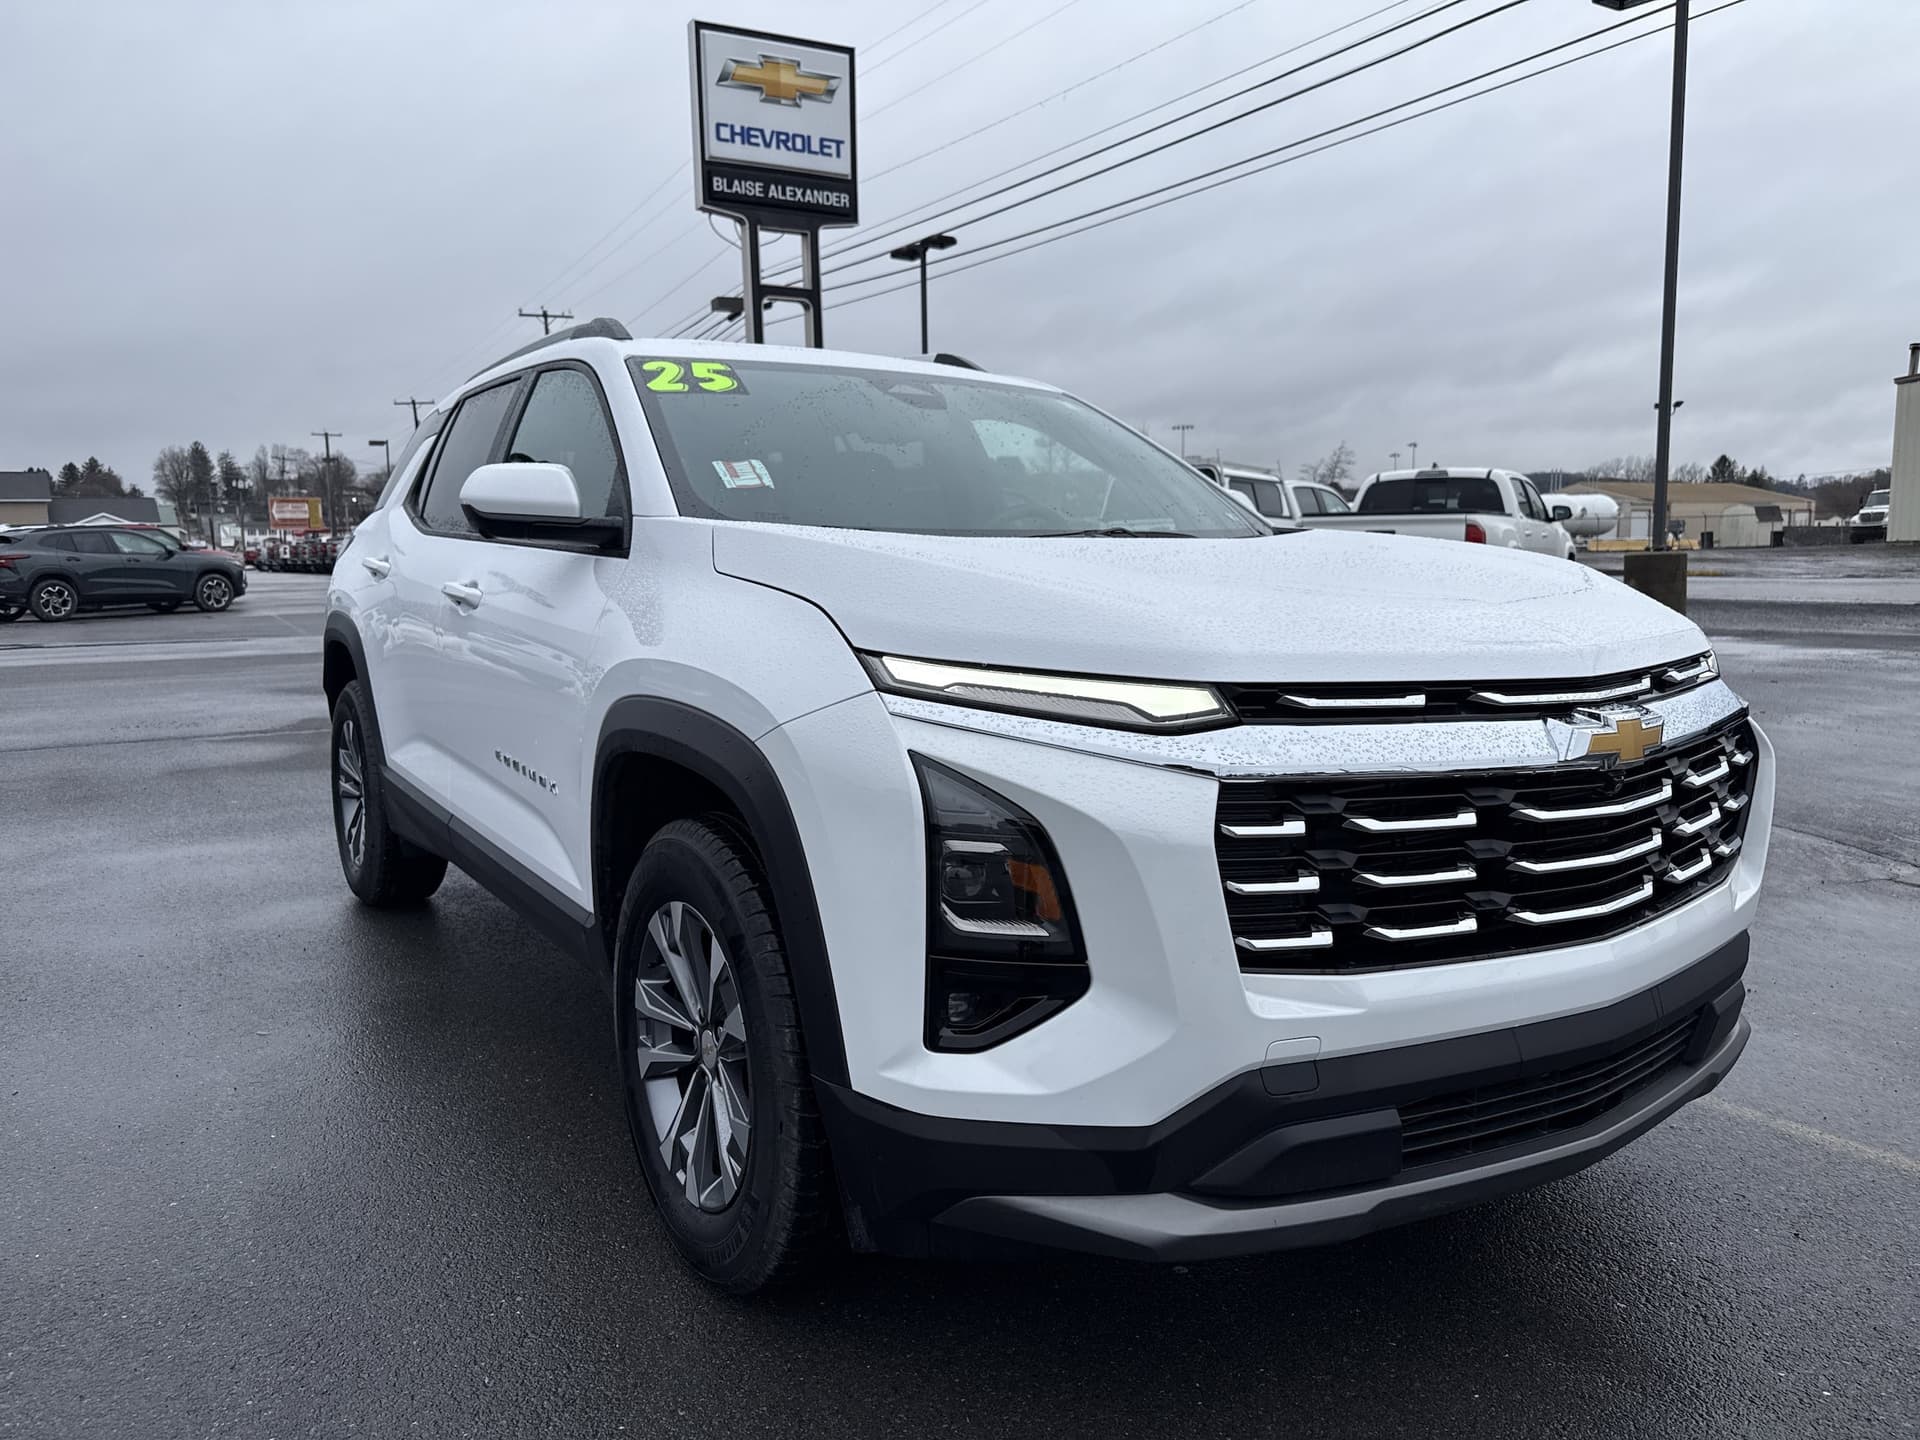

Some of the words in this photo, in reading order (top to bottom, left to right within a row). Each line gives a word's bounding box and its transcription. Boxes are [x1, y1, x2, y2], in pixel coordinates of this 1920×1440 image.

[715, 122, 845, 159] CHEVROLET
[712, 176, 765, 198] BLAISE
[768, 183, 850, 208] ALEXANDER
[642, 360, 738, 393] 25
